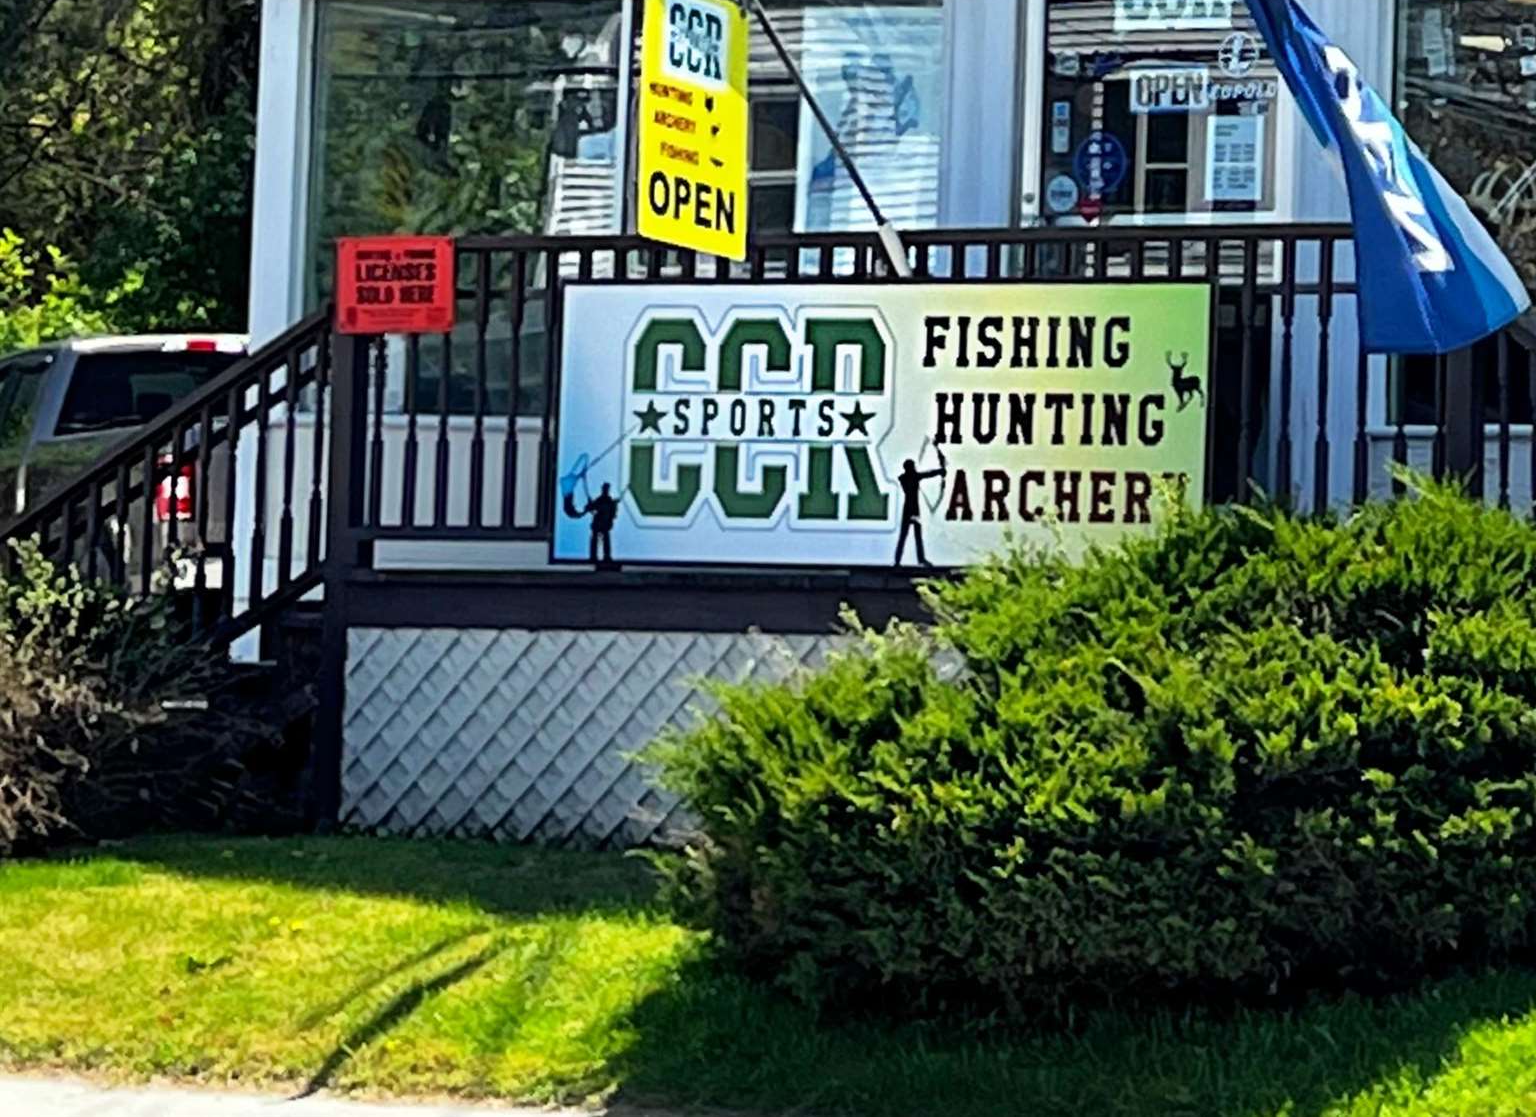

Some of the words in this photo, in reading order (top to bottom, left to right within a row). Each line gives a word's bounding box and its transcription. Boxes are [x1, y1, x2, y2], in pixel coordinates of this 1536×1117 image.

[670, 2, 722, 80] CCR
[1136, 73, 1205, 106] OPEN
[654, 110, 696, 134] ARCHERY
[660, 141, 699, 165] FISHING
[649, 170, 735, 234] OPEN
[922, 315, 1131, 368] FISHING
[628, 316, 889, 520] CCR
[673, 398, 836, 438] SPORTS
[934, 392, 1165, 445] HUNTING
[944, 469, 1191, 524] ARCHER
